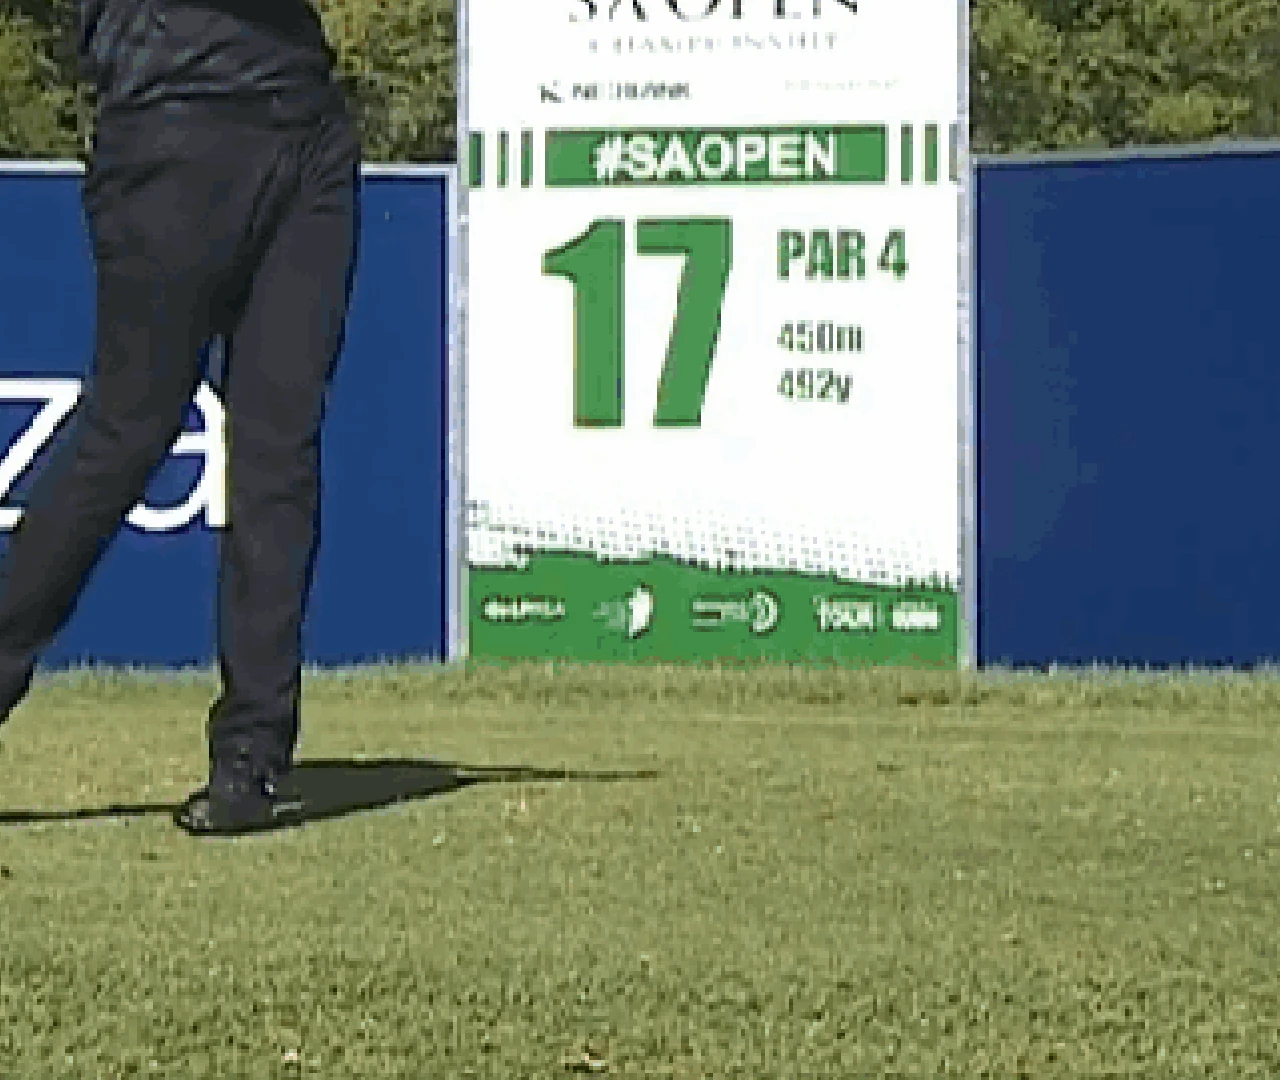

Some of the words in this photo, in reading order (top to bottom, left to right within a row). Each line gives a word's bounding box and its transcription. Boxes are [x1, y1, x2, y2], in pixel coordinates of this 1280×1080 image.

[595, 132, 839, 178] #SAOPEN
[776, 228, 866, 281] PAR
[876, 228, 910, 281] 4
[540, 215, 734, 430] 17
[776, 319, 863, 355] 450m
[776, 367, 854, 403] 492y
